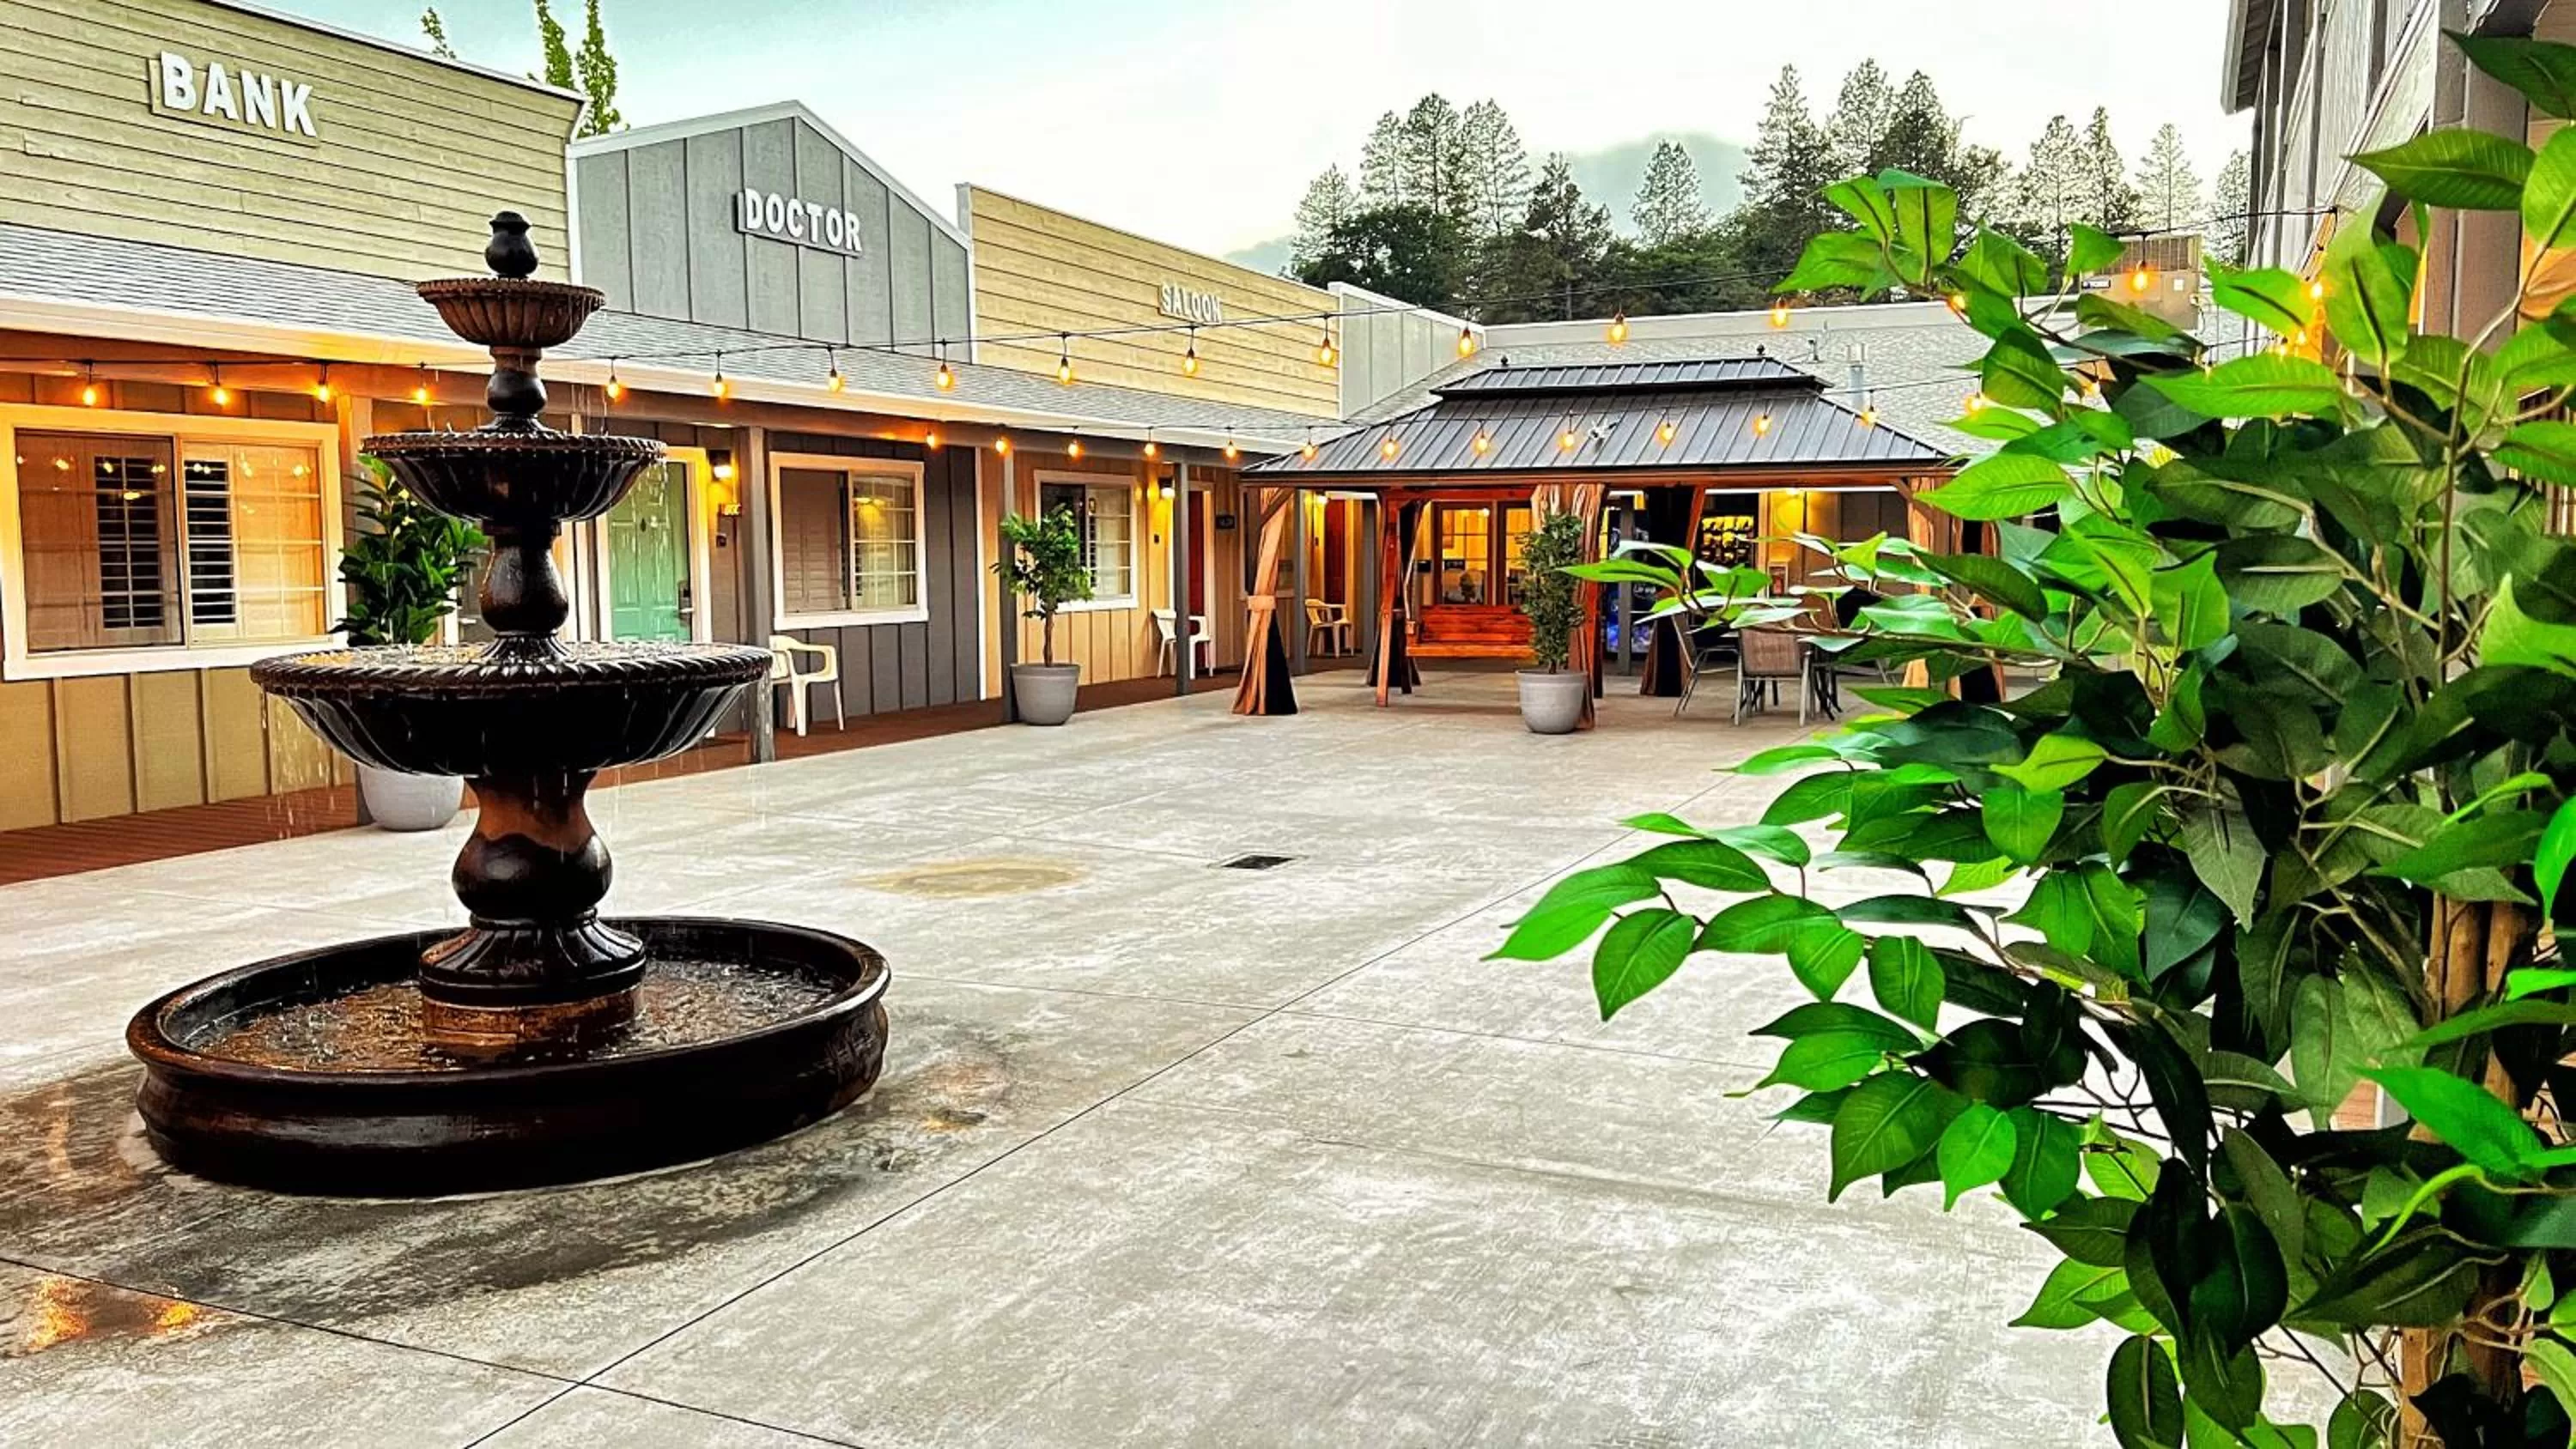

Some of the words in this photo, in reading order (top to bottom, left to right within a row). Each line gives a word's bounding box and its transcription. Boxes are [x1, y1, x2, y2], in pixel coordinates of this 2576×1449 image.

[161, 51, 317, 137] BANK
[744, 187, 862, 252] DOCTOR
[1162, 282, 1222, 324] SALOON
